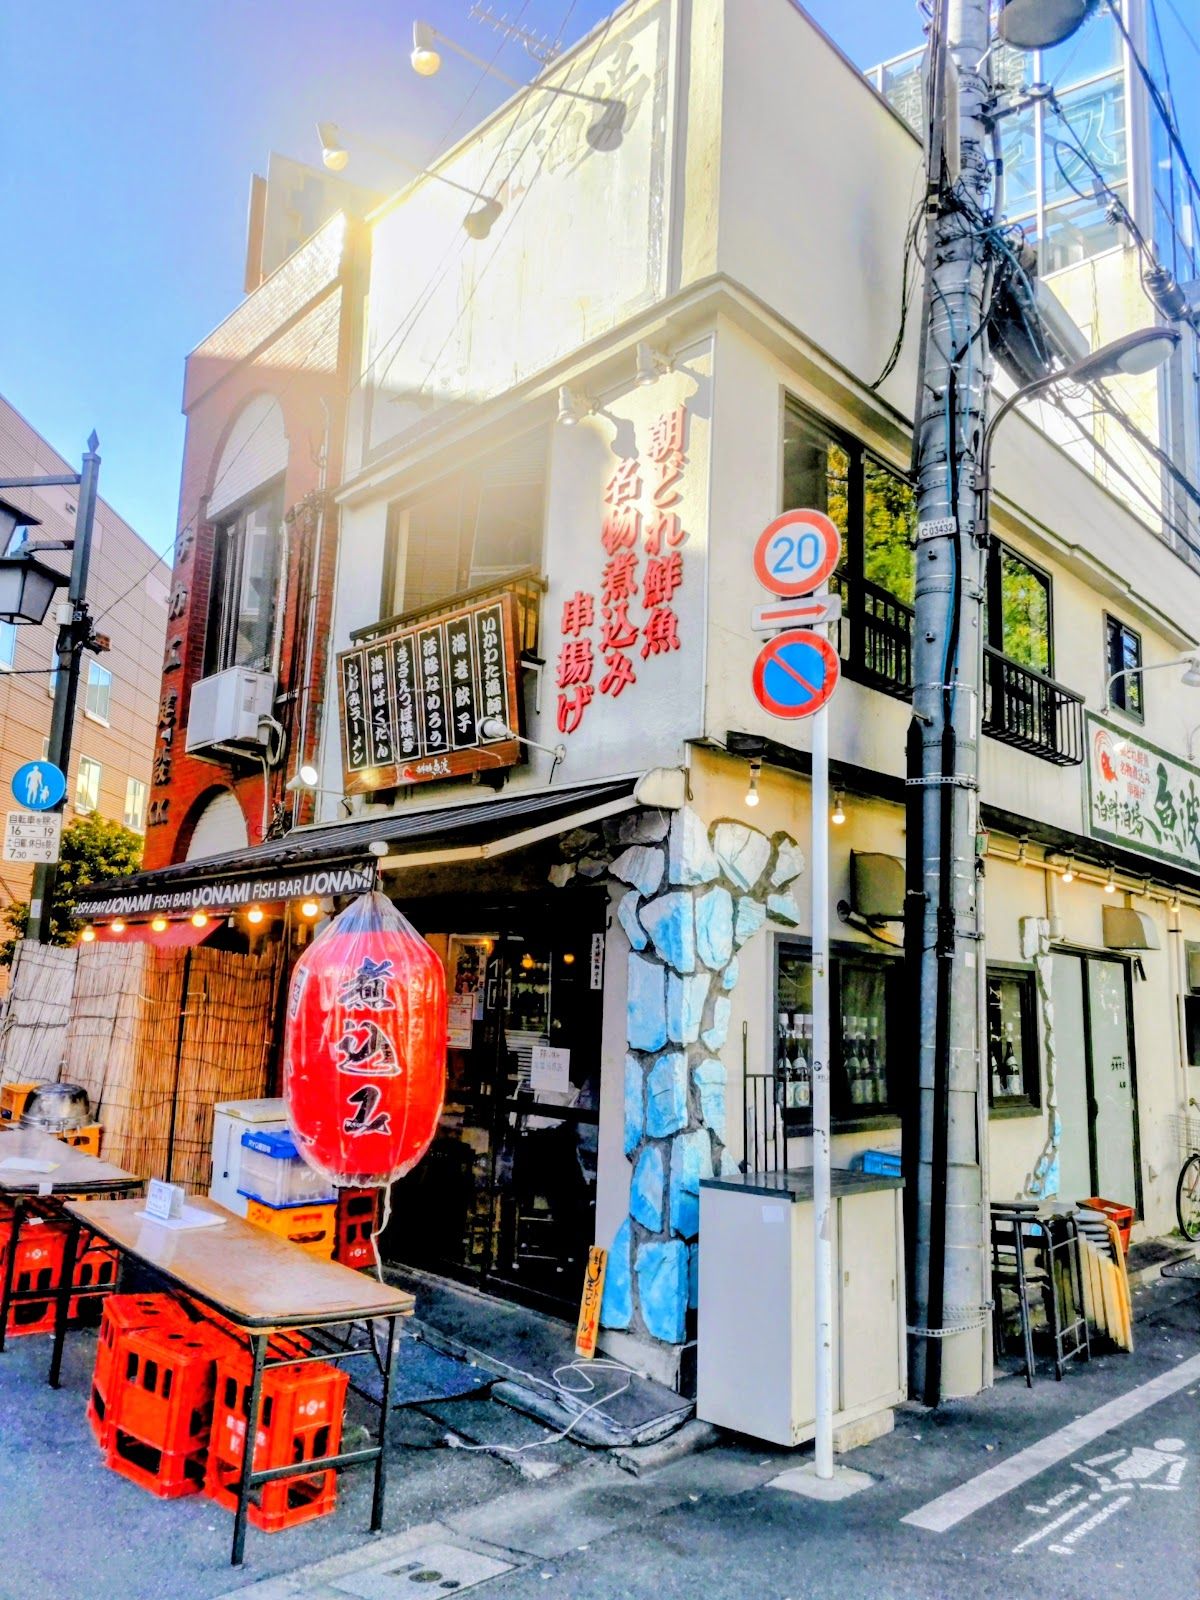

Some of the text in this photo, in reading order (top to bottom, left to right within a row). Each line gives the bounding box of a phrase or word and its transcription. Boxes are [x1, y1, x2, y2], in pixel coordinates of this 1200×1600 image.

[599, 458, 641, 697] 名物煮込み
[772, 532, 819, 574] 20
[371, 655, 389, 759] 海鮮ばくだん
[452, 632, 472, 734] 海老餃子
[481, 616, 504, 725] いかわた漁師
[556, 590, 596, 734] 串揚げ
[12, 826, 21, 836] 16
[44, 828, 54, 837] 19
[45, 850, 52, 859] 9
[89, 900, 105, 913] BAR
[105, 894, 150, 914] UONAMI
[153, 895, 173, 909] FISH
[173, 891, 191, 907] BAR
[192, 882, 250, 908] UONAMI
[252, 881, 277, 899] FISH
[278, 879, 302, 896] BAR
[303, 865, 374, 895] UONAMI
